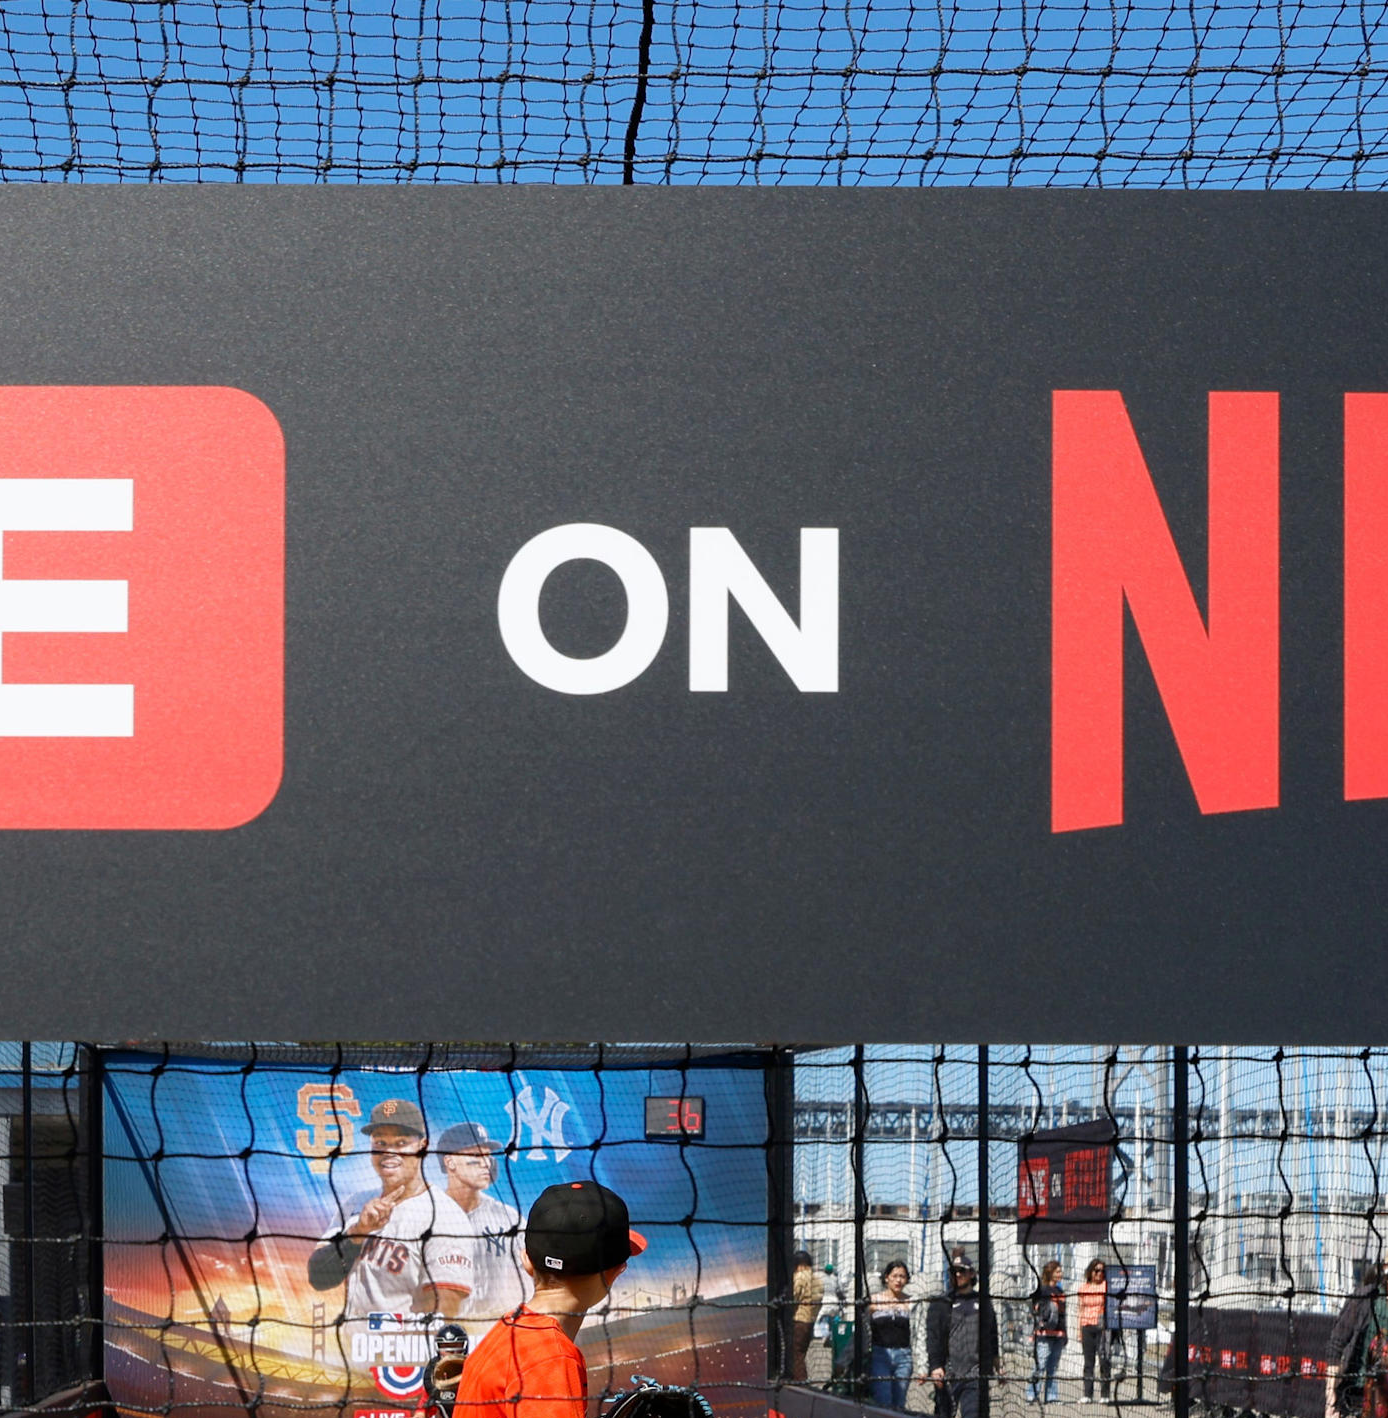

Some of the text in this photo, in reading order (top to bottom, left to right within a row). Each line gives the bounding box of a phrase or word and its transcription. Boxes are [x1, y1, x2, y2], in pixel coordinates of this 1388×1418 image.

[497, 522, 839, 695] ON
[666, 1100, 701, 1131] 36
[437, 1254, 473, 1269] GIANTS
[351, 1333, 437, 1362] OPENIN
